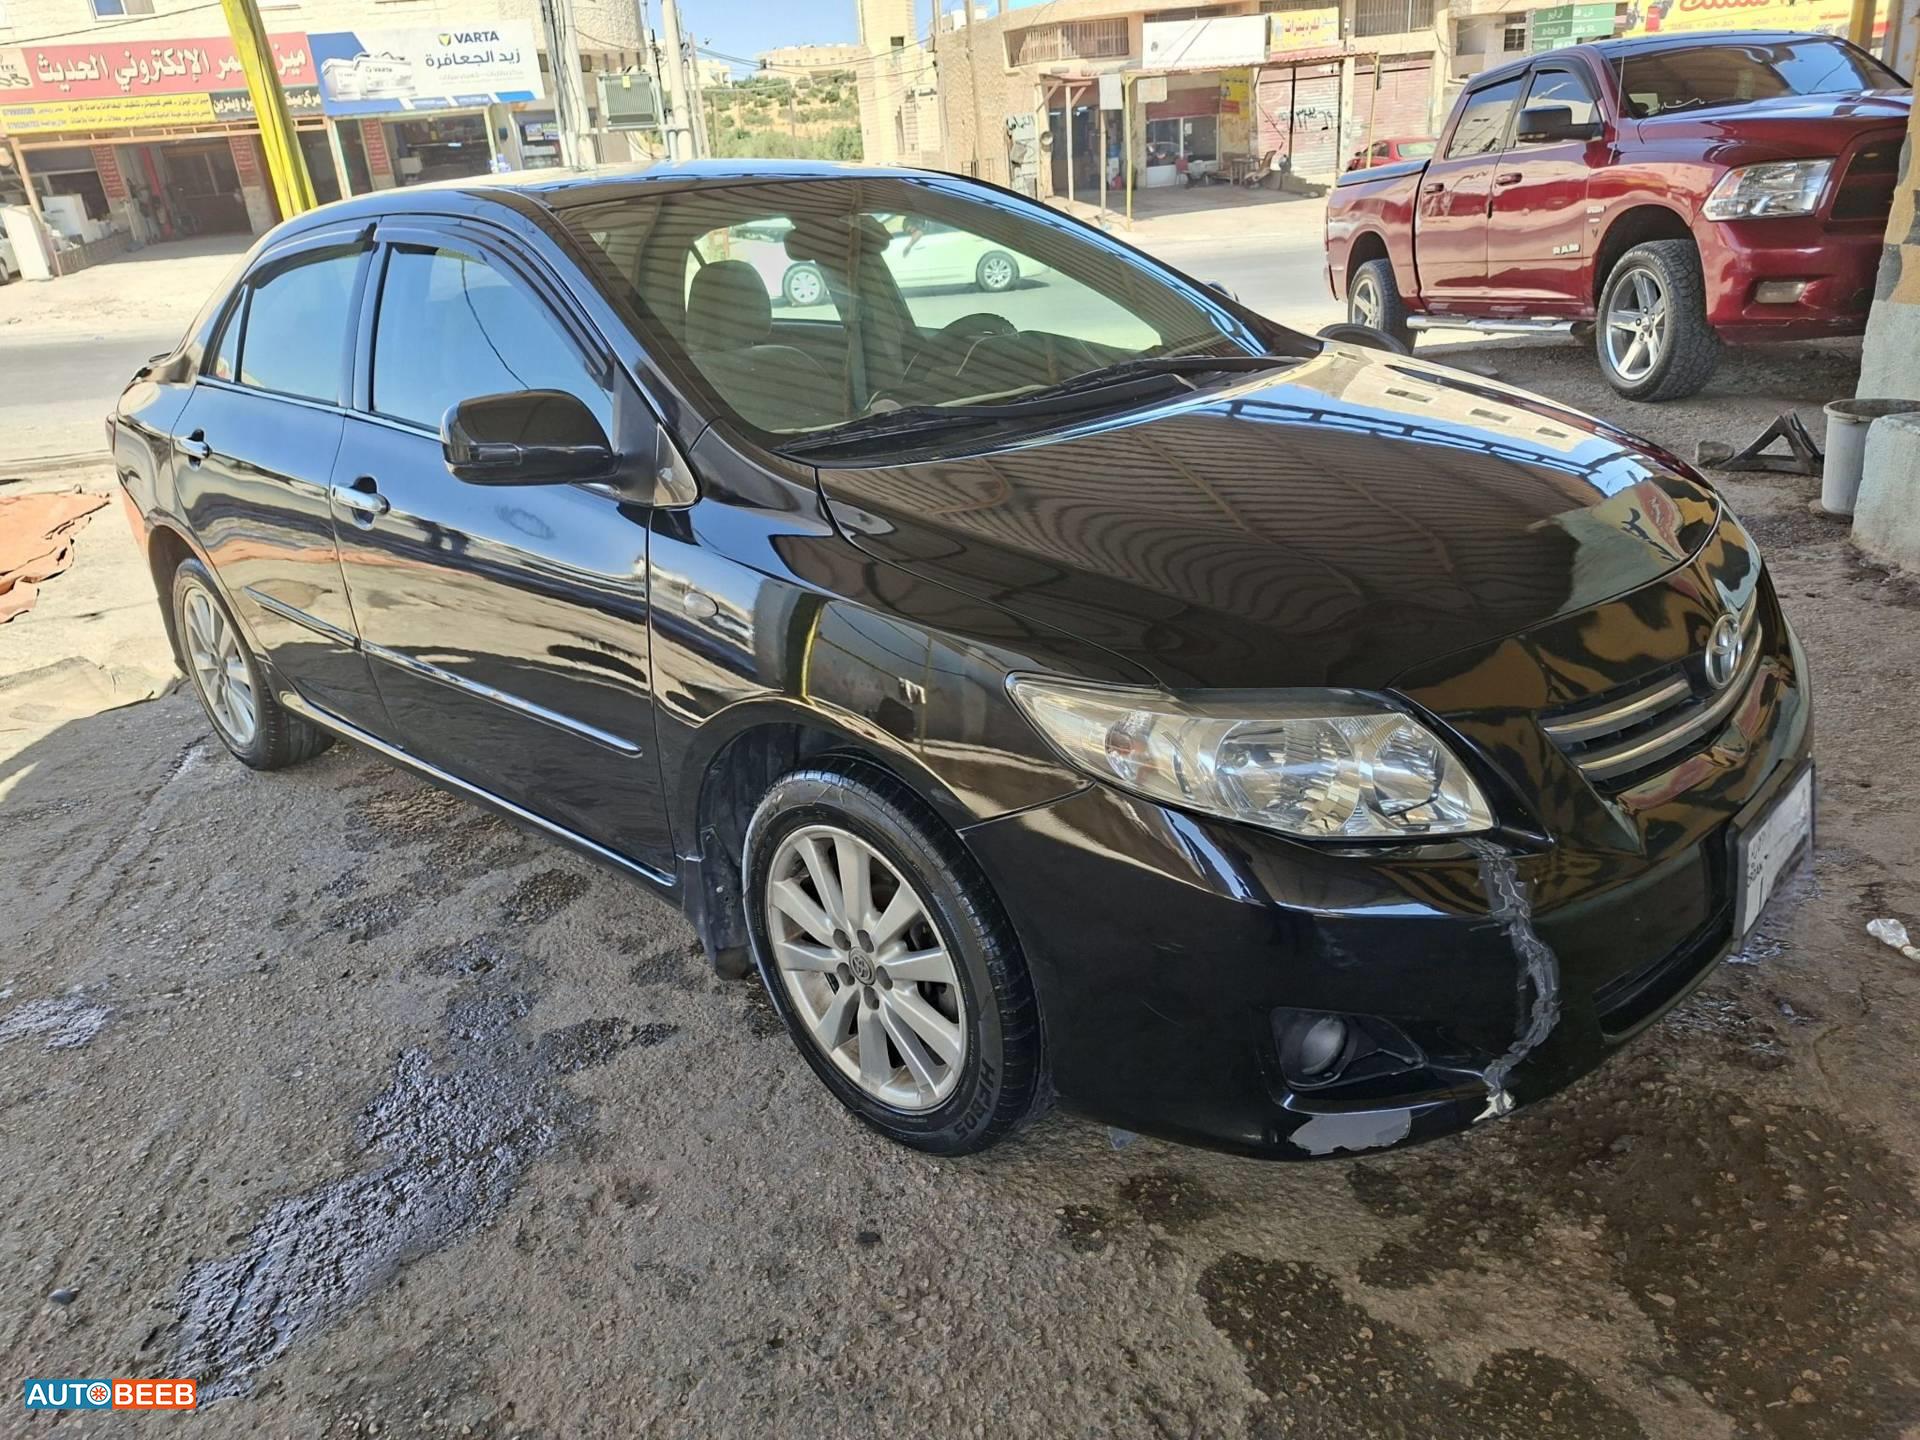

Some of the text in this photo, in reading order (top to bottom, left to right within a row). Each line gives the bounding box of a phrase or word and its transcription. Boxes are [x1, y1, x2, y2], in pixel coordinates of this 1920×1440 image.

[454, 31, 499, 44] VARTA
[425, 48, 521, 69] زيد الجعافرة
[37, 52, 110, 93] الحديث
[114, 47, 210, 93] الإلكتروني
[1553, 243, 1580, 255] RAM
